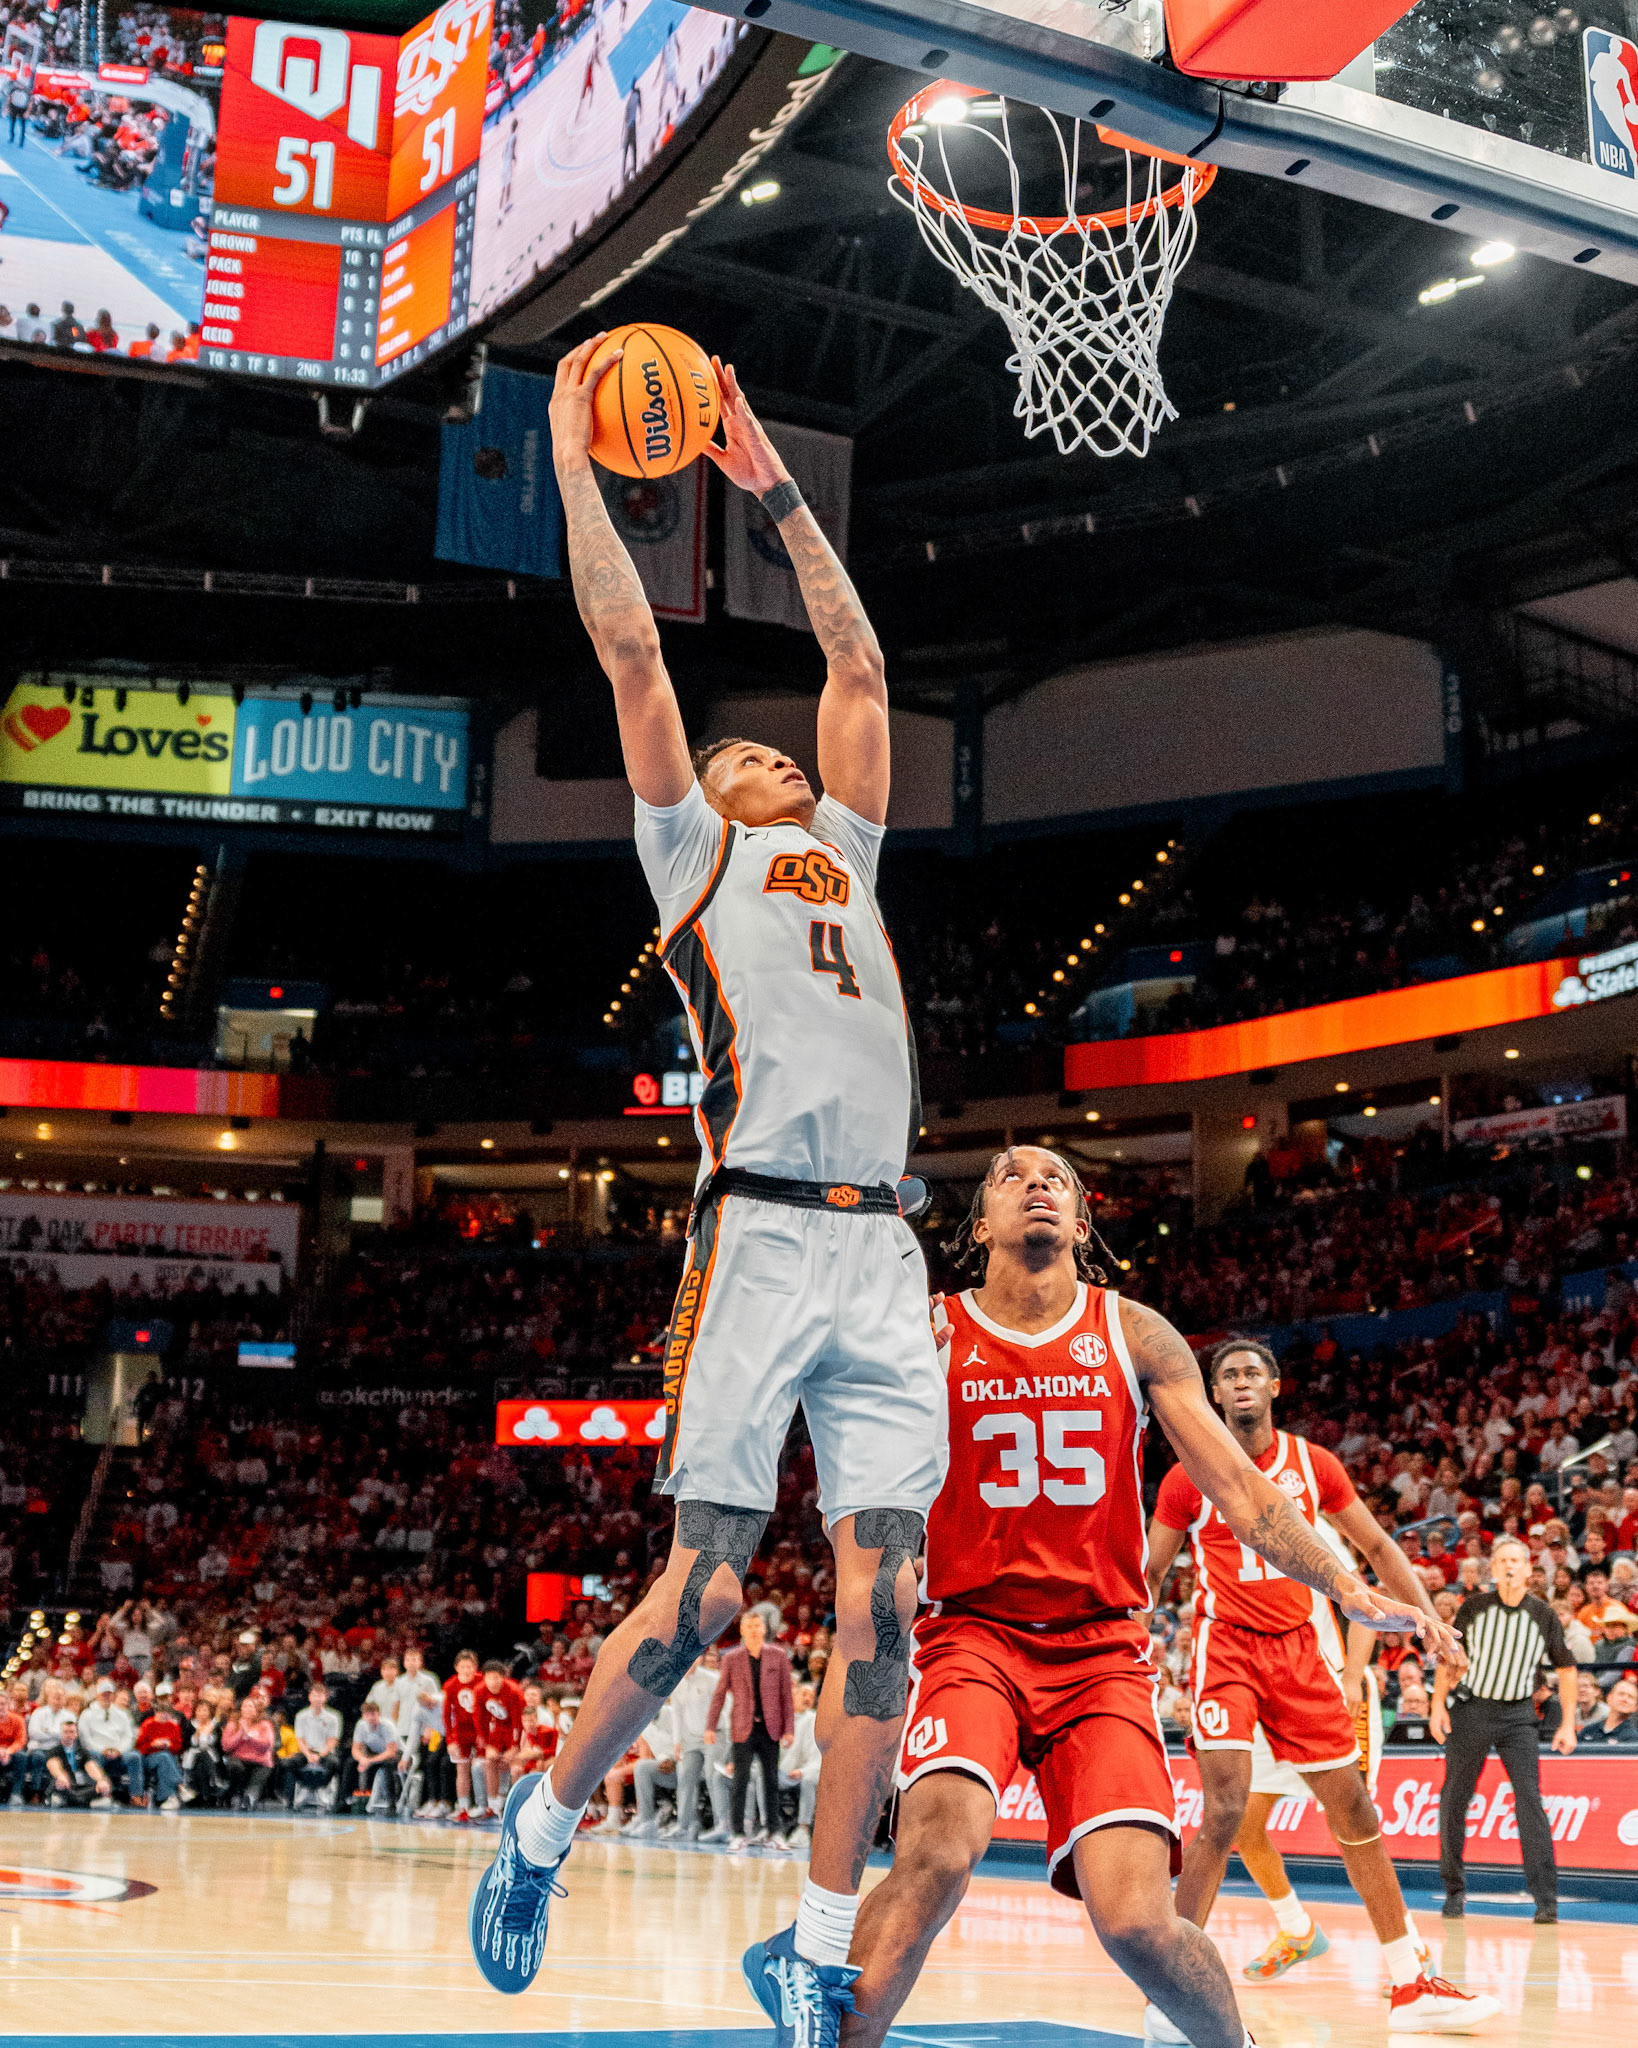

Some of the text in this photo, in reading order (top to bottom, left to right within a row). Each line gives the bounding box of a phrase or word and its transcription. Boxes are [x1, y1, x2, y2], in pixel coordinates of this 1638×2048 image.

[420, 107, 456, 191] 51
[1599, 141, 1628, 172] NBA
[273, 137, 335, 209] 51
[214, 210, 383, 245] PLAYER PTS FL
[210, 232, 257, 253] BROWN
[345, 250, 362, 267] 10
[369, 252, 378, 268] 1
[208, 256, 242, 274] PACK
[343, 273, 360, 290] 15
[368, 275, 376, 291] 1
[206, 279, 244, 298] JONES
[364, 298, 375, 314] 2
[204, 302, 240, 321] DAVIS
[342, 320, 353, 335] 3
[364, 321, 373, 337] 1
[202, 326, 234, 344] REID
[360, 344, 371, 361] 0
[208, 351, 226, 367] TO
[230, 353, 241, 370] 3
[247, 356, 263, 372] TF
[296, 361, 322, 379] 2ND
[334, 366, 368, 384] 11:33
[641, 357, 672, 462] Wilson
[243, 715, 353, 784] LOUD
[367, 718, 458, 793] CITY
[23, 789, 434, 831] BRING THE THUNDER EXIT NOW
[762, 849, 850, 907] OSU
[809, 920, 862, 1000] 4
[826, 1185, 860, 1208] OSU
[95, 1221, 166, 1245] PARTY
[175, 1224, 271, 1251] TERRACE
[1072, 1336, 1105, 1365] SEC
[961, 1375, 1112, 1403] OKLAHOMA
[972, 1410, 1107, 1509] 35
[1198, 1699, 1229, 1737] OU
